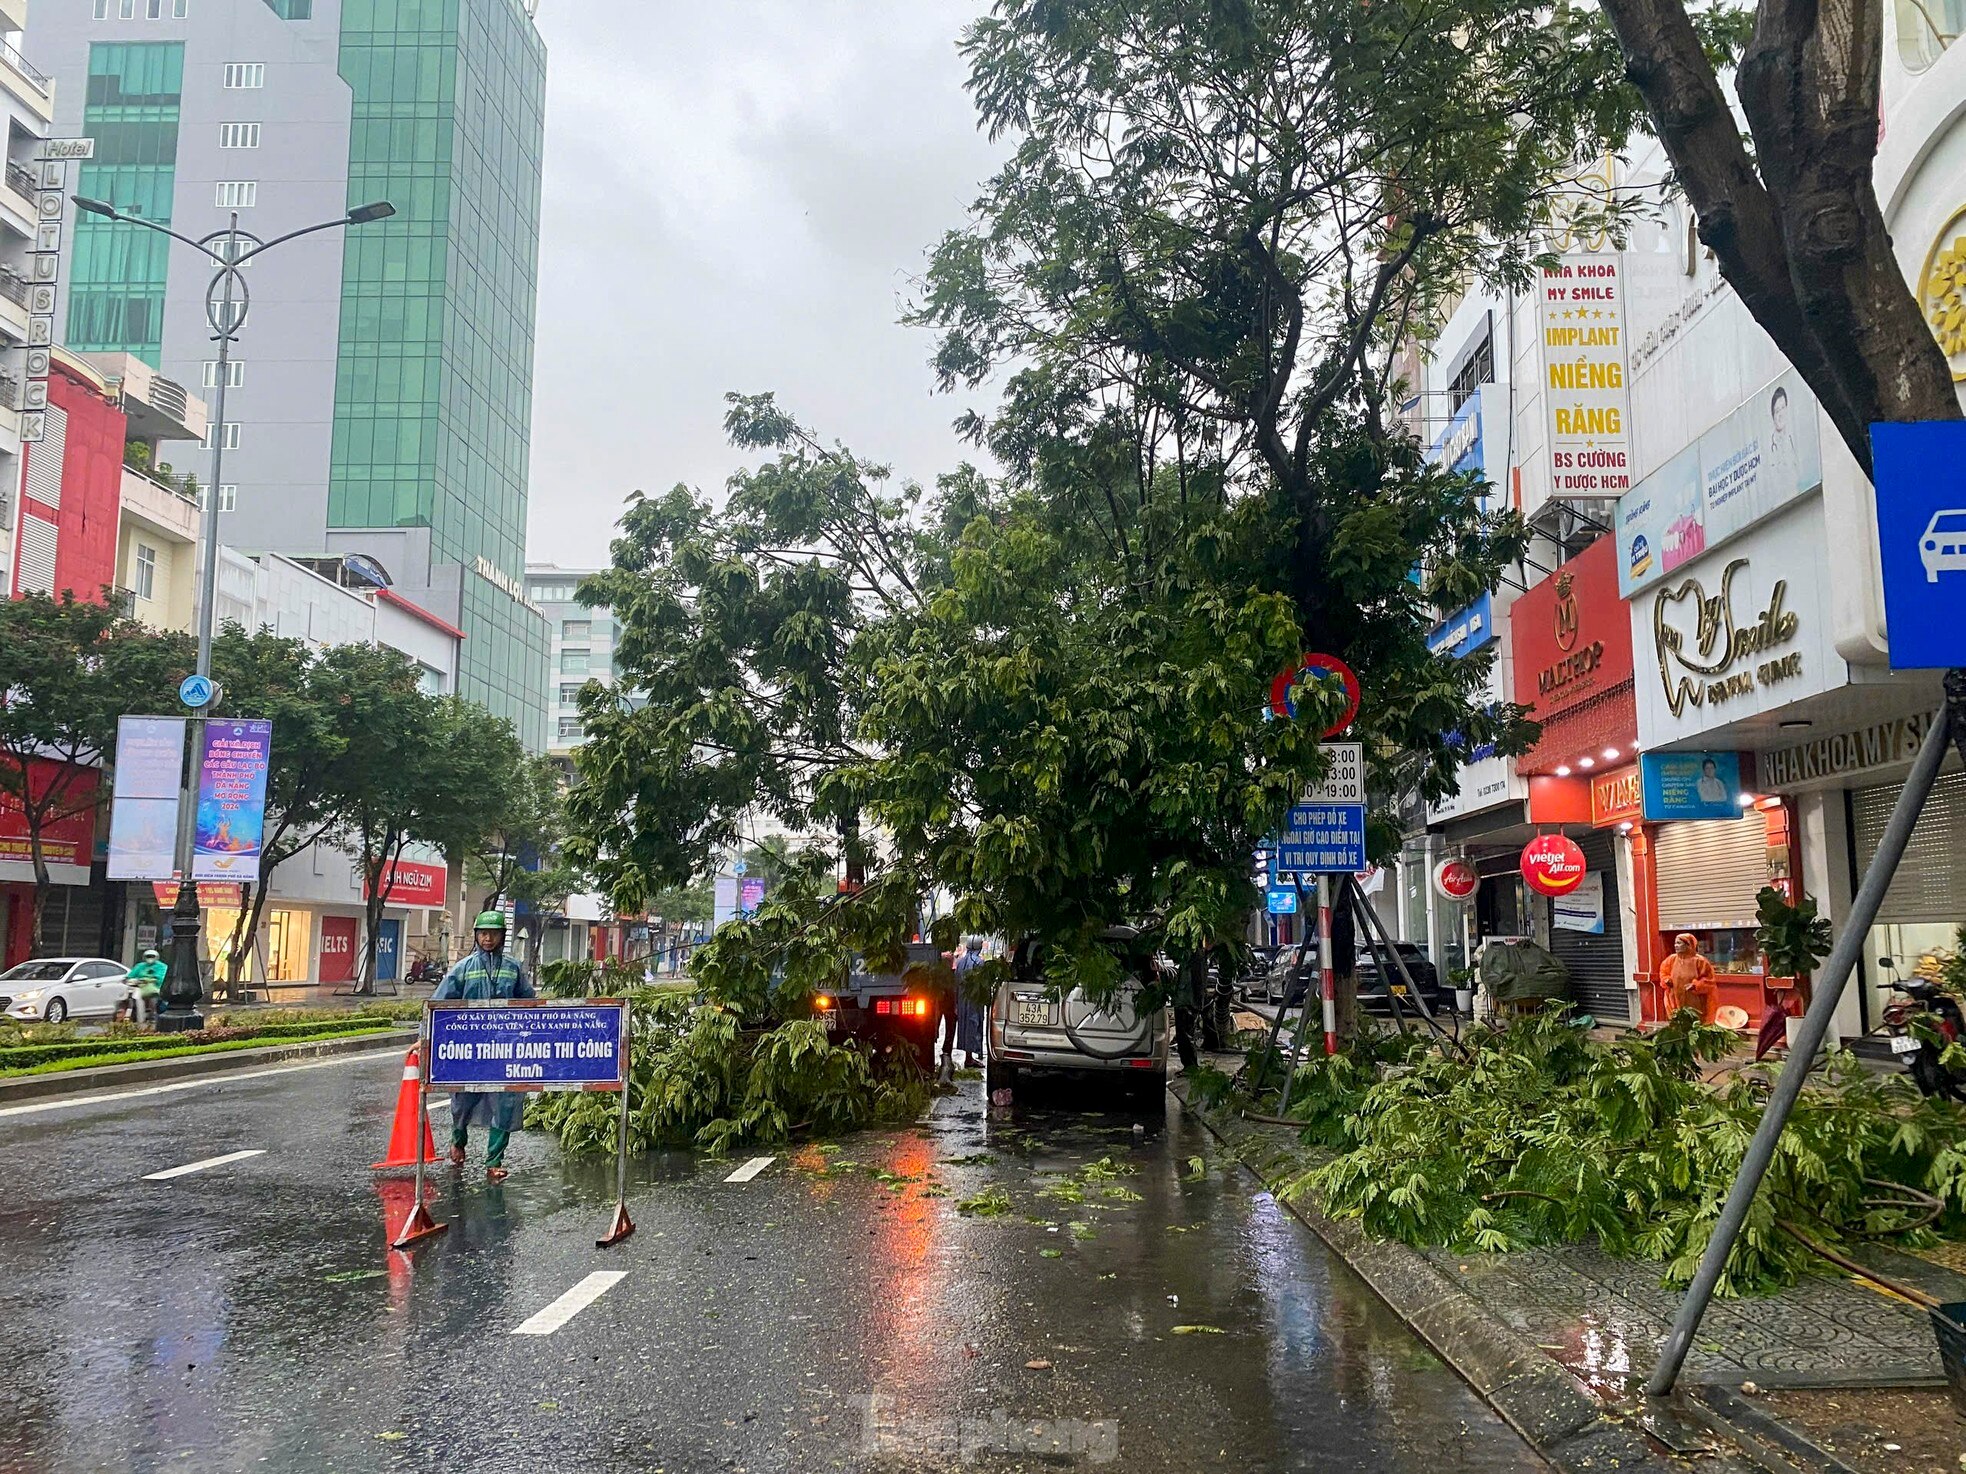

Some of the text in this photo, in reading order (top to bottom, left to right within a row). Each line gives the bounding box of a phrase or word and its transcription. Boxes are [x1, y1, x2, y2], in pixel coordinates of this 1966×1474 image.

[48, 138, 92, 154] Hotel
[1577, 264, 1616, 278] KHOA
[1548, 286, 1615, 300] MY SMILE
[1546, 327, 1620, 347] IMPLANT
[1550, 354, 1623, 389] NIỀNG
[1555, 402, 1621, 435] RĂNG
[1554, 448, 1627, 468] BS CƯỜNG
[1554, 474, 1630, 492] Y DƯỢC HCM
[477, 554, 508, 592] THÀNH
[508, 577, 523, 602] LỢI
[1764, 748, 1801, 787] NHA
[1803, 732, 1859, 779] KHOA
[1862, 719, 1898, 767] MY
[204, 759, 219, 768] CÁC
[212, 770, 256, 780] THÀNH PHỐ
[215, 780, 226, 789] ĐÀ
[1325, 784, 1357, 798] 19:00
[221, 802, 240, 811] 2024
[1293, 807, 1348, 825] CHO PHÉP ĐỖ XE
[1303, 827, 1315, 845] GIỜ
[1316, 831, 1330, 845] CAO
[1331, 825, 1349, 845] ĐIỂM
[1349, 831, 1361, 848] TẠI
[1285, 847, 1358, 868] VỊ TRÍ QUY ĐỊNH ĐỖ XE
[1529, 850, 1566, 866] Vietjet
[1549, 863, 1581, 874] Air.com
[403, 869, 418, 886] NGŨ
[419, 874, 433, 887] ZIM
[1444, 872, 1457, 885] Air
[321, 935, 348, 953] IELTS
[456, 1011, 597, 1022] SỞ XÂY DỰNG THÀNH PHỐ ĐÀ NẴNG
[1025, 1003, 1042, 1014] 43A
[445, 1022, 468, 1031] CÔNG
[469, 1023, 480, 1031] TY
[481, 1022, 504, 1030] CÔNG
[505, 1021, 524, 1030] VIÊN
[530, 1021, 547, 1030] CÂY
[571, 1020, 583, 1029] ĐÀ
[584, 1020, 607, 1029] NẴNG
[1019, 1013, 1048, 1024] 35279
[438, 1038, 613, 1060] CÔNG TRÌNH ĐANG THI CÔNG
[505, 1063, 543, 1078] 5Km/h
